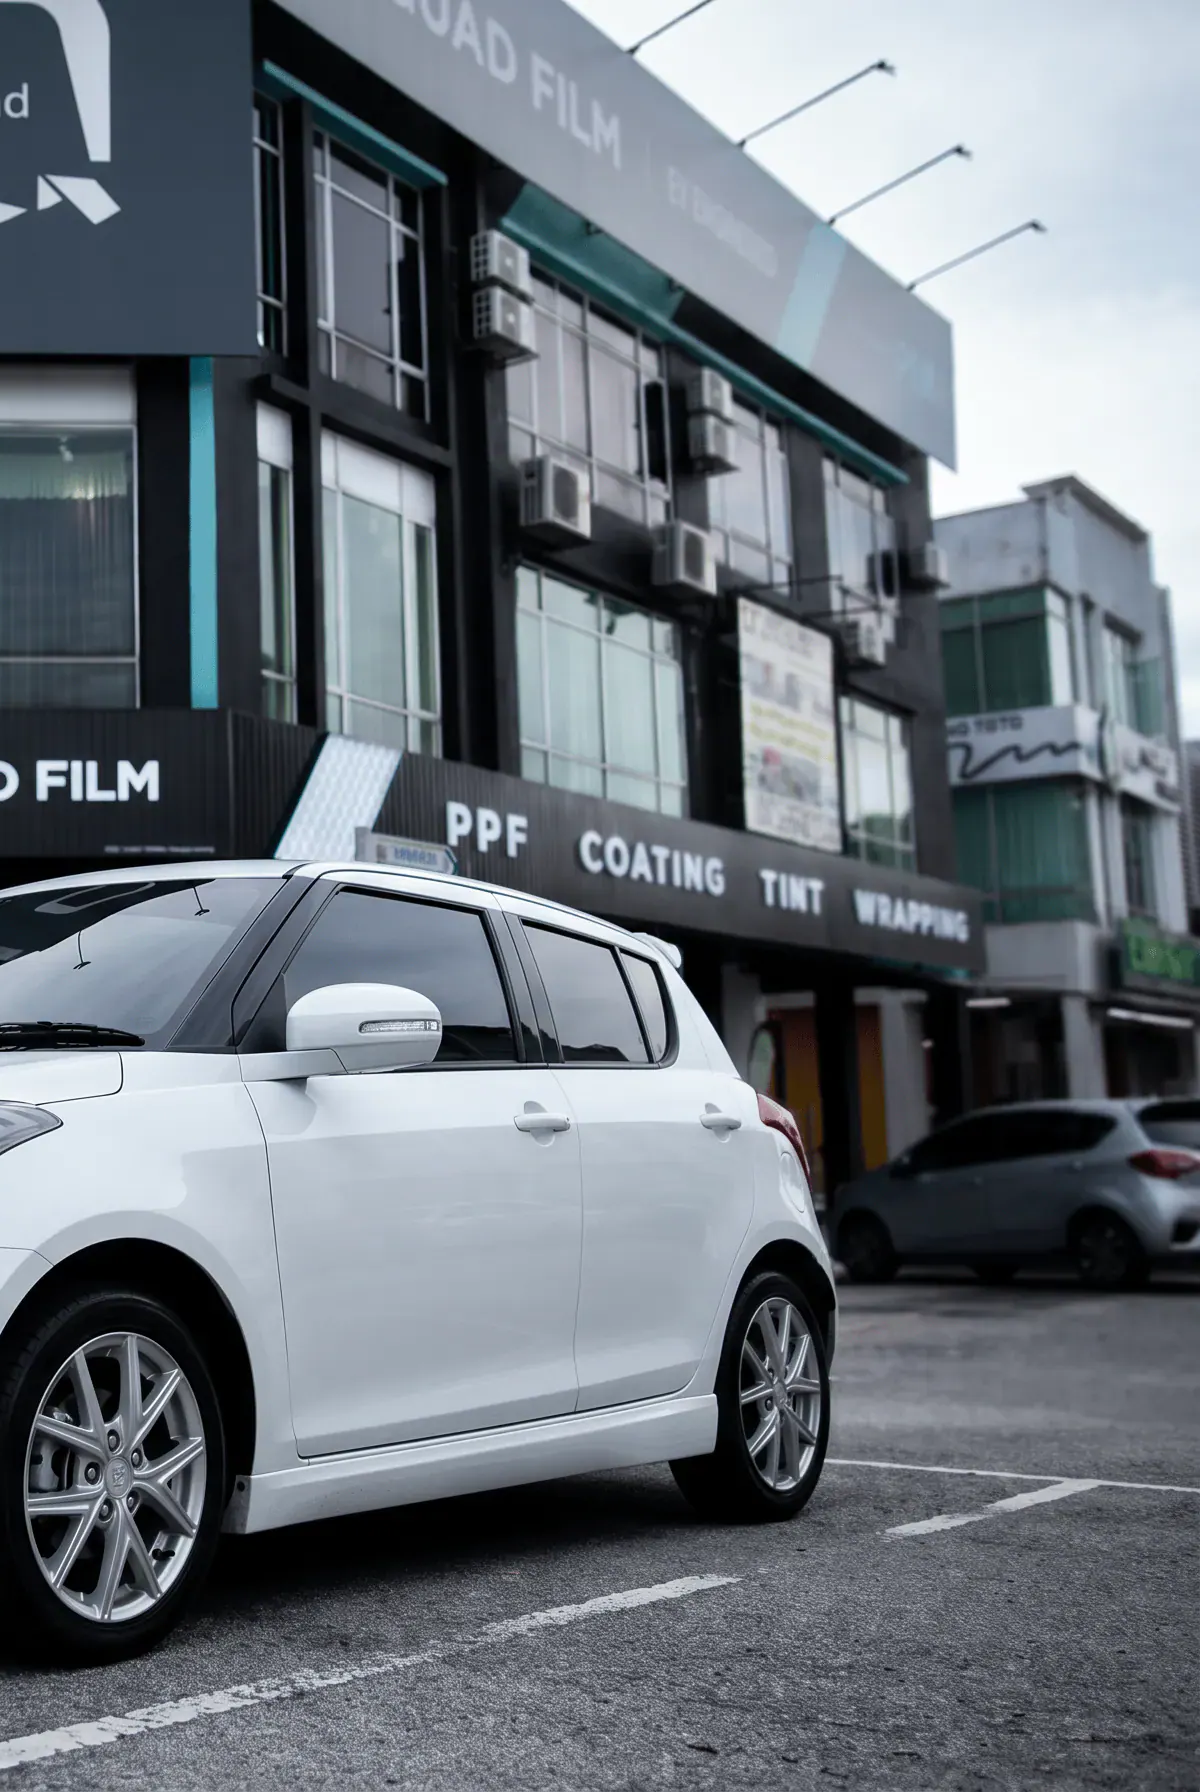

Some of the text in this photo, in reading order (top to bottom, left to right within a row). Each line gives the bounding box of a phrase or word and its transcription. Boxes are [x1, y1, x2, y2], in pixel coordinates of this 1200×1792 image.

[393, 0, 622, 171] UAD FILM
[35, 759, 160, 802] FILM
[445, 800, 968, 943] PPF COATING TINT WRAPPING
